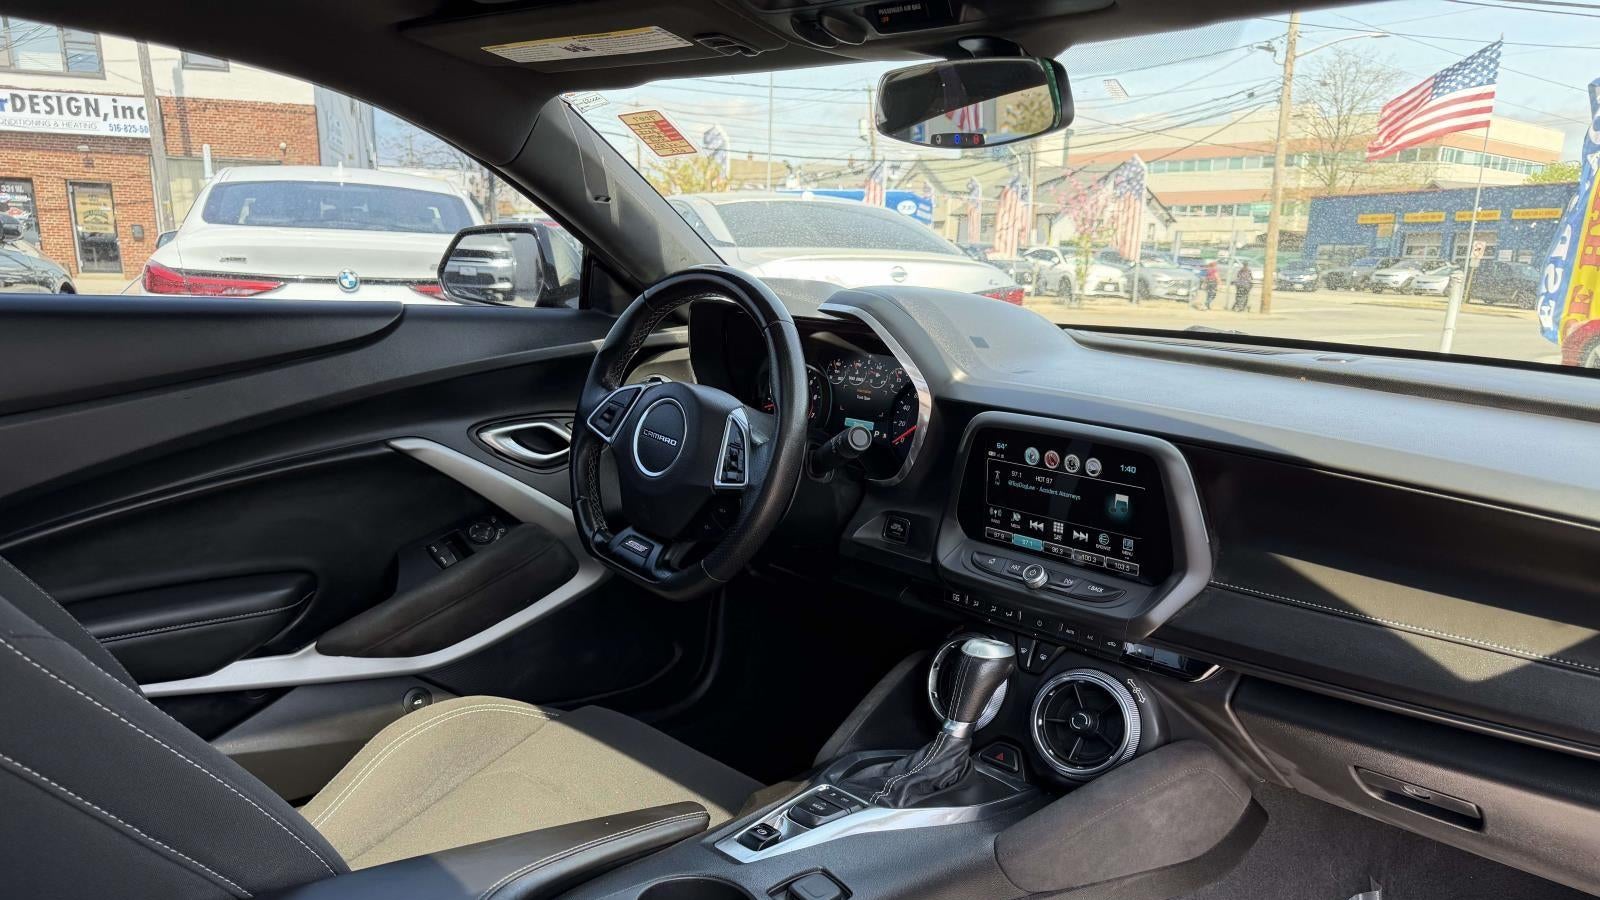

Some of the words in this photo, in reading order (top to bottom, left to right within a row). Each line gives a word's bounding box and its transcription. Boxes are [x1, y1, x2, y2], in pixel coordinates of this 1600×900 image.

[643, 430, 677, 446] CAMARO
[1120, 464, 1137, 474] 1:40
[1011, 470, 1022, 478] 97.1
[1035, 475, 1045, 483] HOT
[1039, 486, 1058, 495] Accident
[1059, 491, 1080, 500] Attorneys
